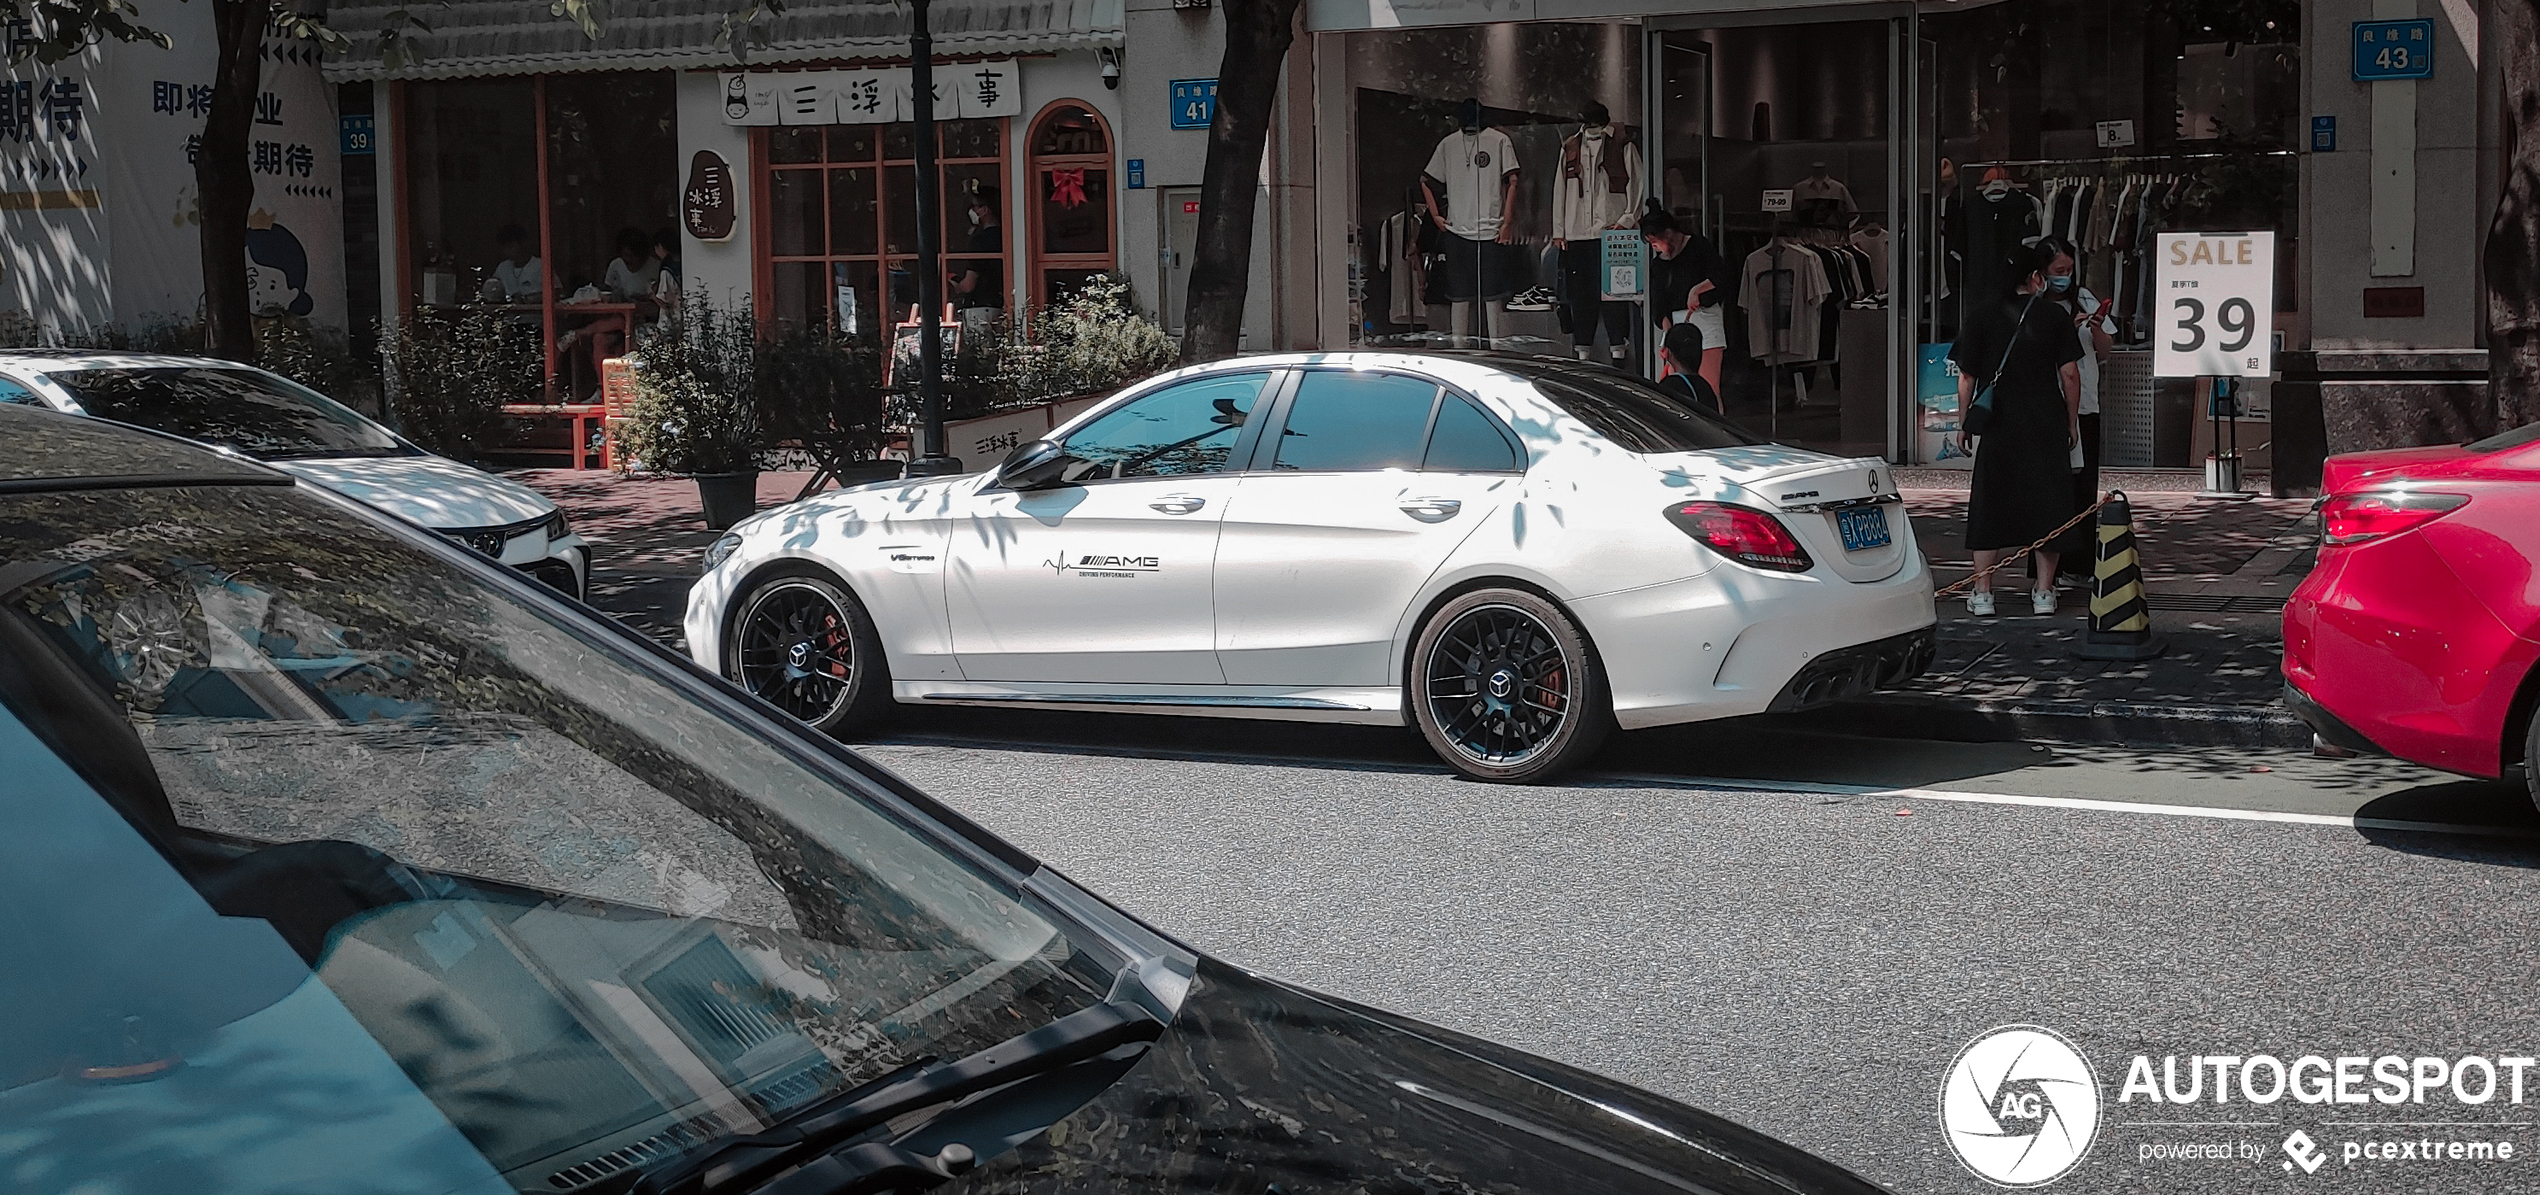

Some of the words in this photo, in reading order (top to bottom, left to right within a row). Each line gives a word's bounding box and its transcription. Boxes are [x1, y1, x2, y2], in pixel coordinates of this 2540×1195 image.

[2375, 47, 2409, 70] 43
[0, 76, 83, 143] 期待
[153, 80, 283, 126] 即将业
[1186, 101, 1207, 120] 41
[350, 133, 367, 150] 39
[2170, 239, 2253, 266] SALE
[2171, 296, 2256, 353] 39
[2246, 357, 2259, 370] 起
